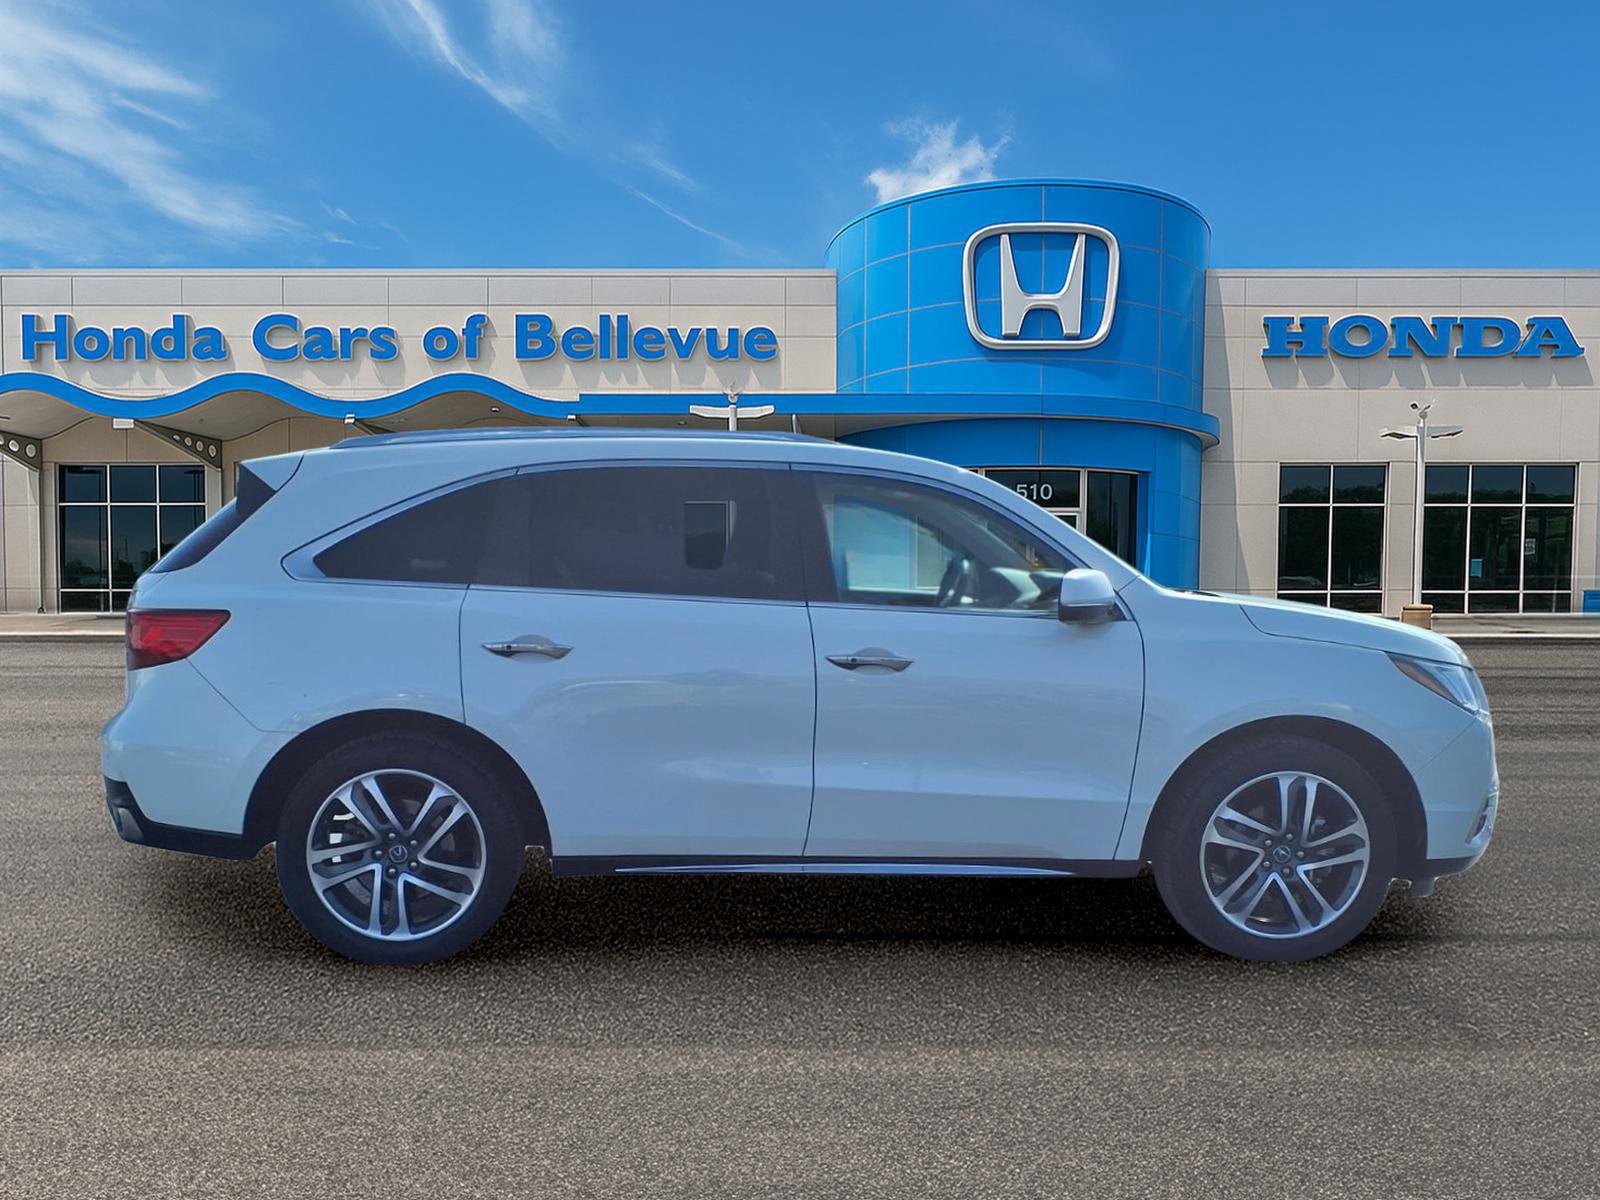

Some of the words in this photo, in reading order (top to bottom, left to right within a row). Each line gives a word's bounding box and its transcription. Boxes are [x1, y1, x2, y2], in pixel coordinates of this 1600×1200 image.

[21, 312, 228, 362] Honda
[252, 312, 400, 362] Cars
[422, 312, 490, 362] of
[514, 312, 780, 362] Bellevue
[1262, 313, 1585, 358] HONDA
[1016, 483, 1053, 500] 510
